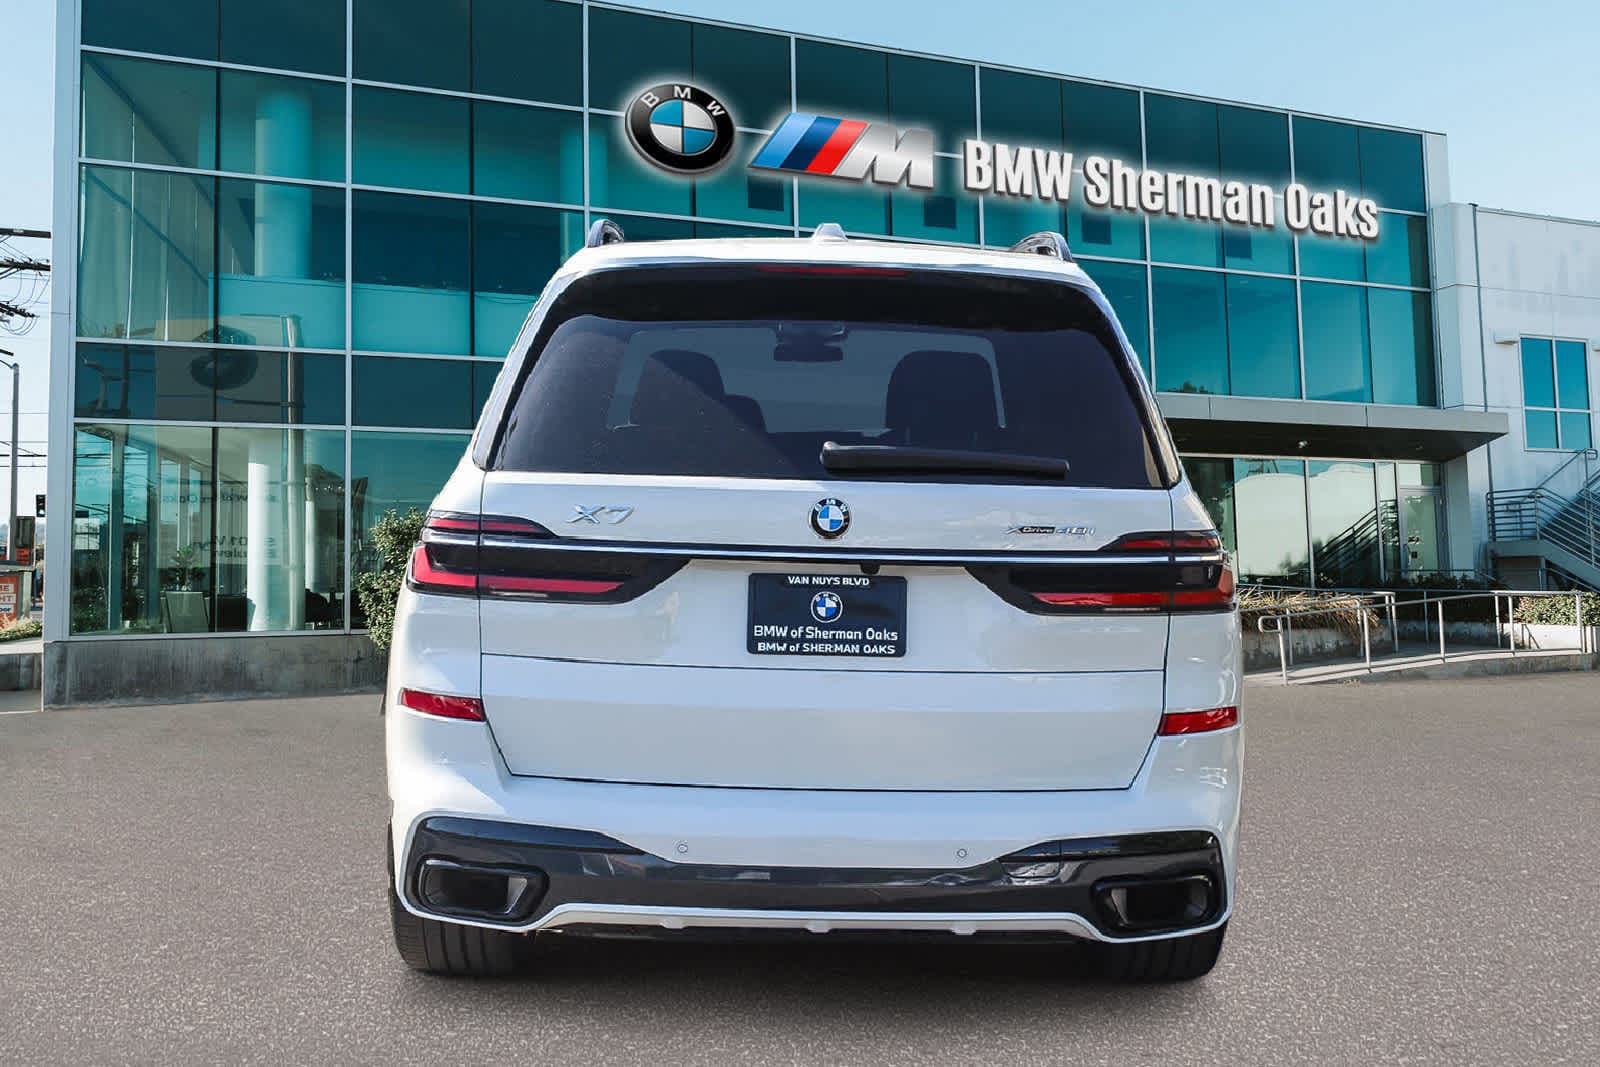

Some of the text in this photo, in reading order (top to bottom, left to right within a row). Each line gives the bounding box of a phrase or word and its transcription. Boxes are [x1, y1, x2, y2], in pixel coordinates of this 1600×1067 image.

[640, 84, 726, 117] BMW
[963, 139, 1379, 240] BMW Sherman Oaks
[565, 504, 635, 525] X7
[788, 576, 870, 586] VAN NUYS BLVD
[754, 625, 898, 641] BMW of Sherman Oaks
[757, 642, 896, 655] BMW of SHERMAN OAKS
